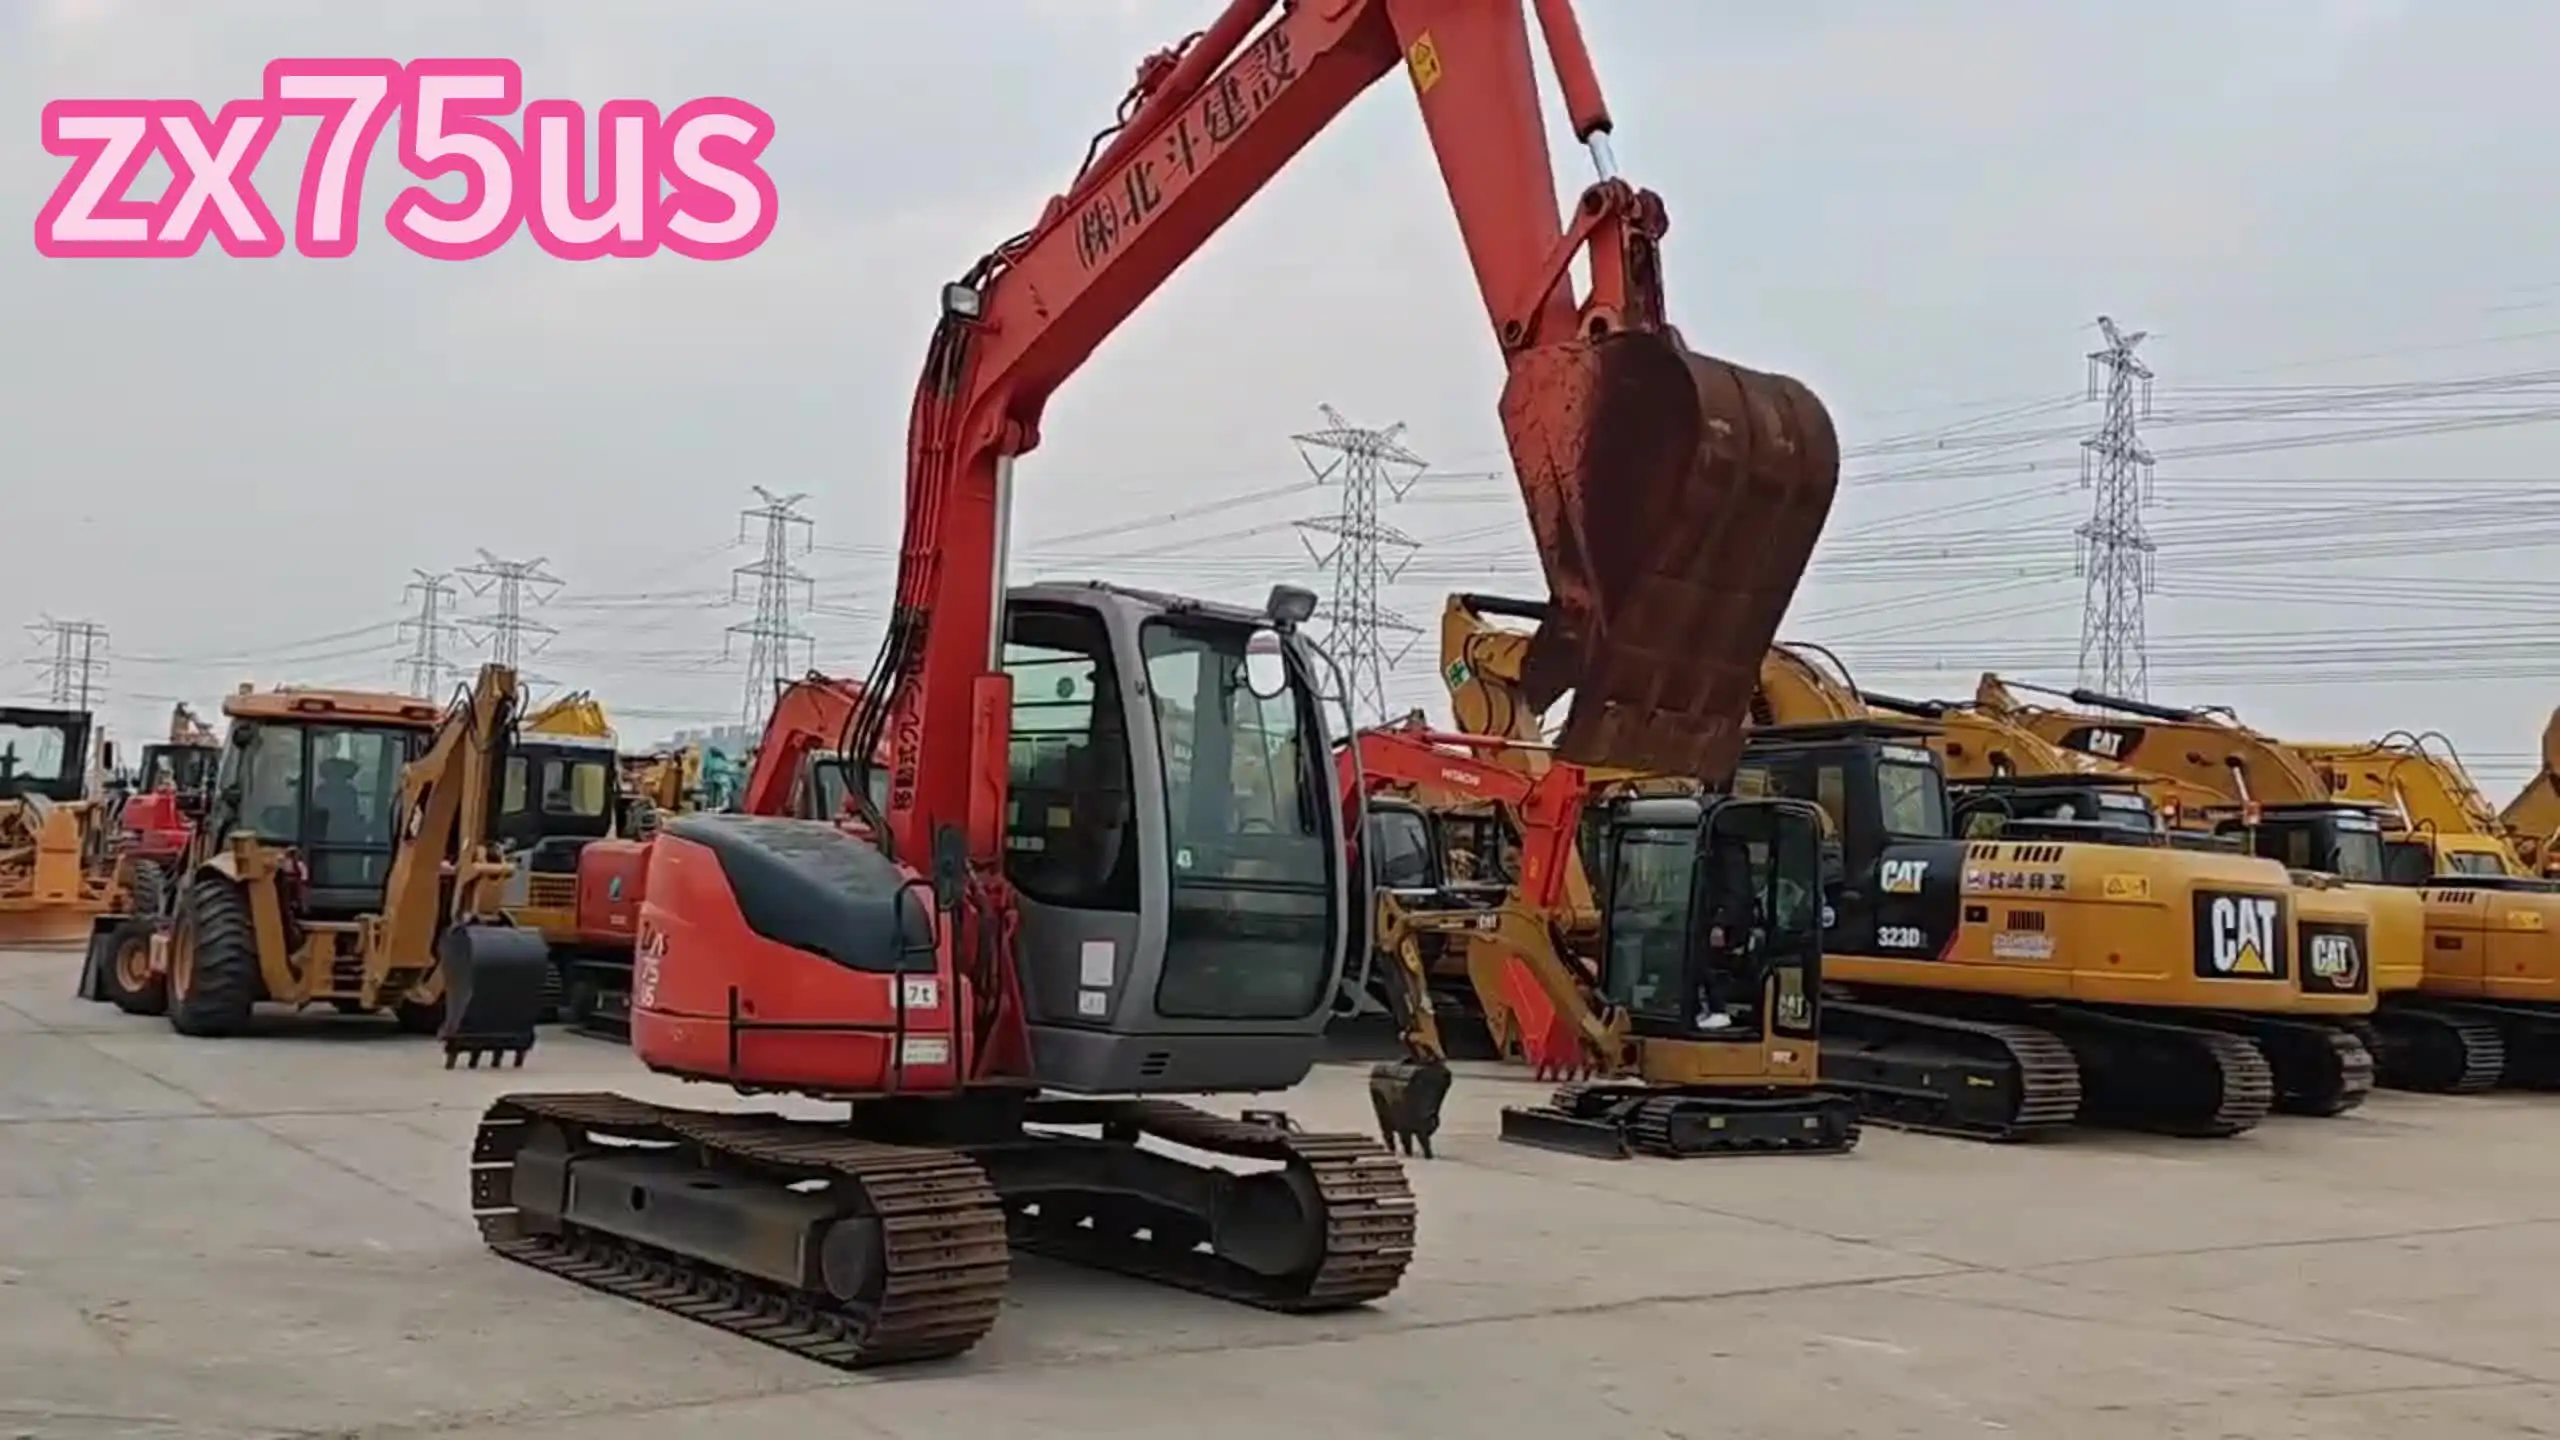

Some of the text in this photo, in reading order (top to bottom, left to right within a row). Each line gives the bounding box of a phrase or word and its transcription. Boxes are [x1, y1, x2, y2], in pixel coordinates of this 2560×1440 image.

[2088, 728, 2123, 755] CAT
[1881, 860, 1928, 893] CAT
[2212, 897, 2276, 973] CAT
[2312, 938, 2348, 973] CAT
